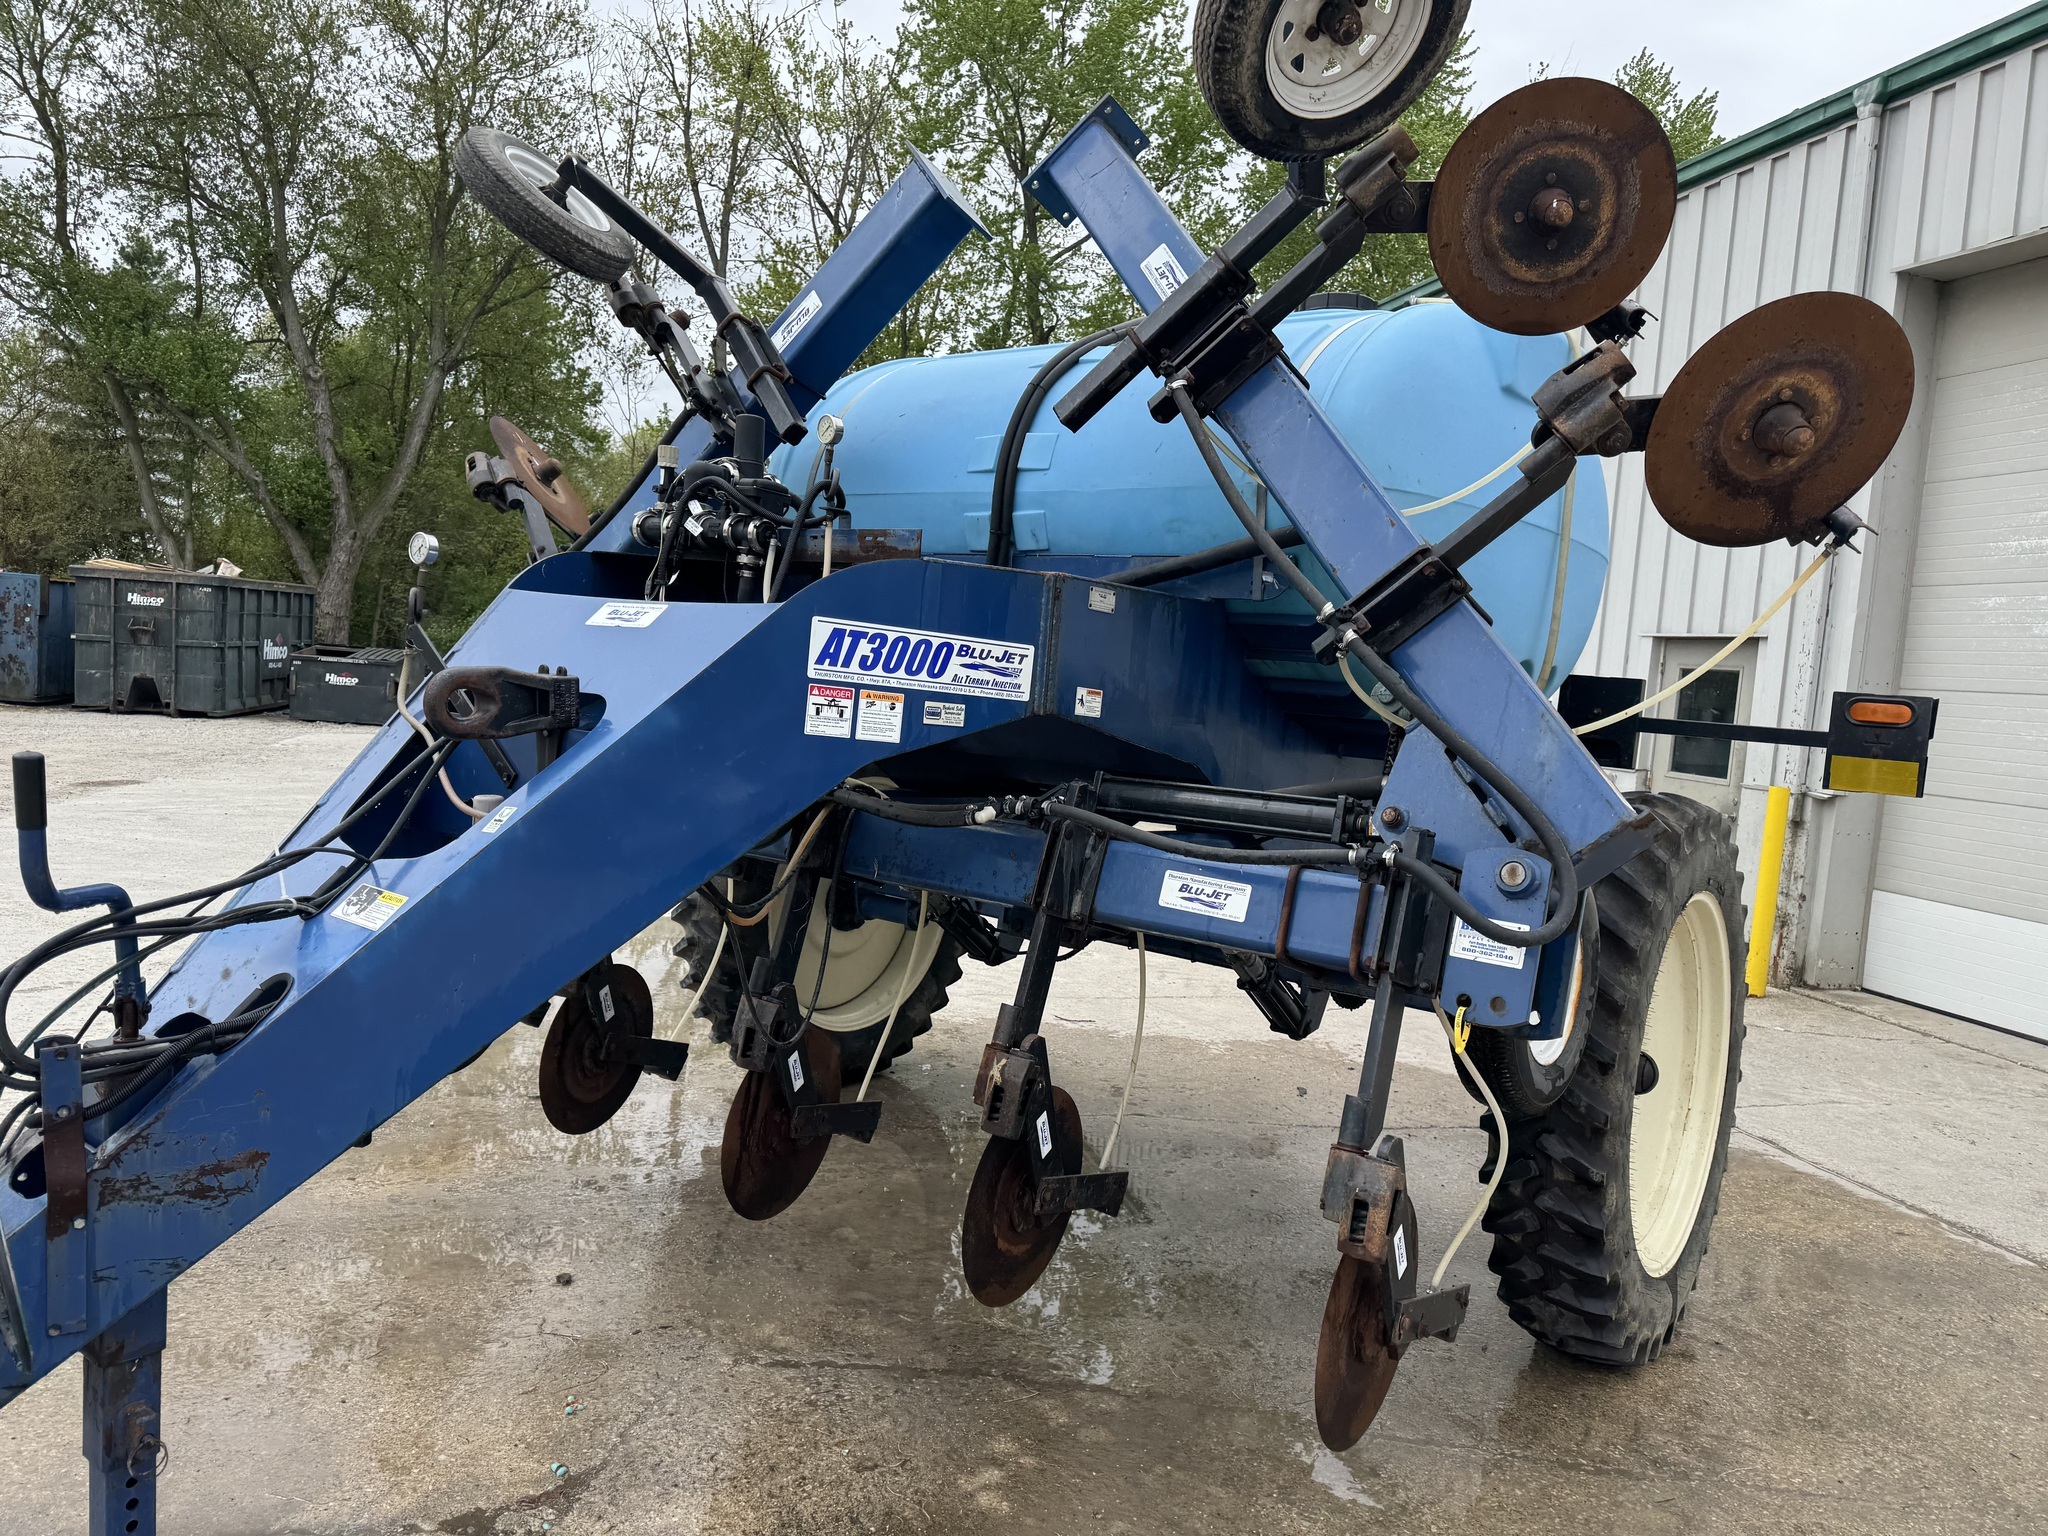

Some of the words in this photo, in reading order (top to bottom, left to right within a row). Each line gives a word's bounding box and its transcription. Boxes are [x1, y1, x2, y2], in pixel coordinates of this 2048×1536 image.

[127, 592, 164, 604] Himco
[607, 609, 649, 617] BLU-JET
[263, 638, 288, 660] Himco
[813, 627, 955, 680] AT3000
[955, 643, 1029, 665] BLU-JET
[325, 672, 359, 684] Himco
[814, 671, 842, 679] THURSTON
[820, 688, 852, 699] DANGER
[872, 693, 900, 702] WARNING
[1178, 883, 1232, 901] BLU-JET
[1223, 883, 1247, 893] Company
